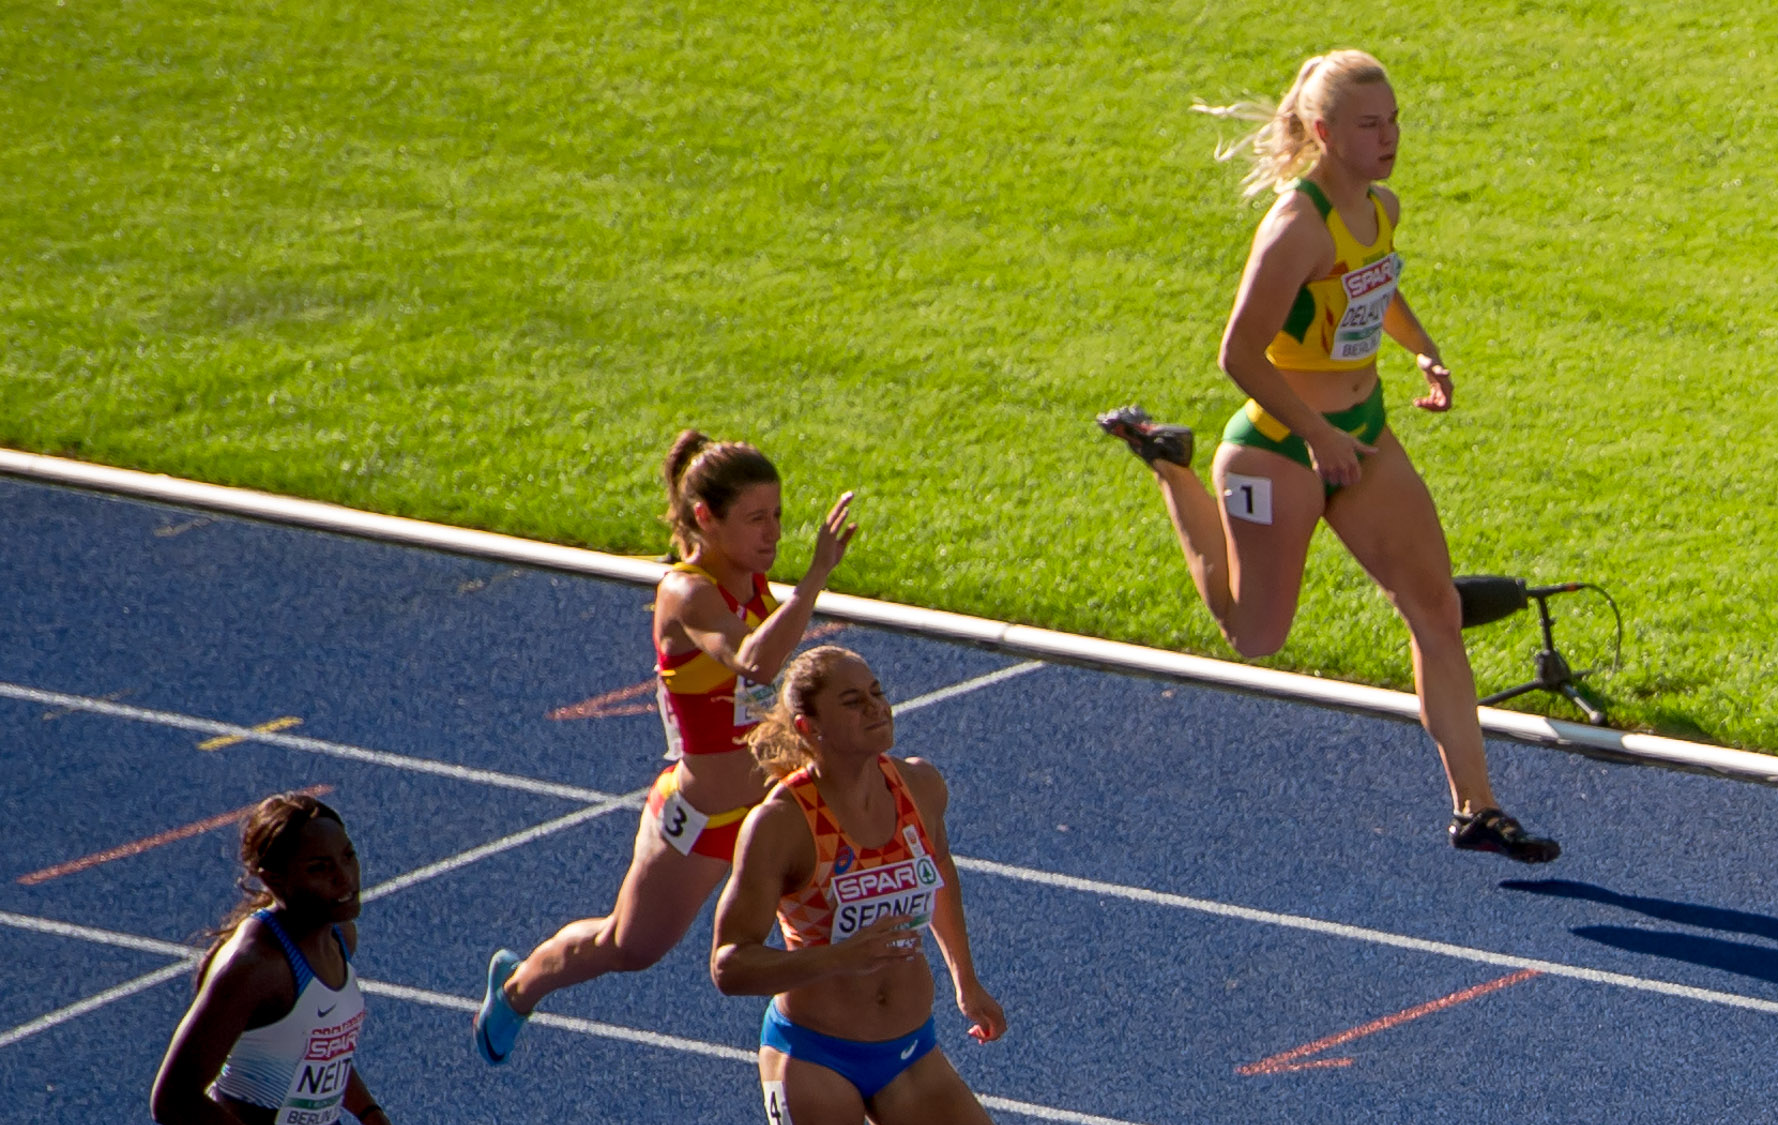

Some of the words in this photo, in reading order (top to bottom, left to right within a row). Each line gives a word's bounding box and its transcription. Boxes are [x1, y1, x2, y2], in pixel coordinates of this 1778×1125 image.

[1347, 260, 1393, 296] SPAR
[1241, 485, 1254, 513] 1
[665, 806, 687, 837] 3
[838, 866, 916, 899] SPAR
[309, 1032, 358, 1058] SPAR
